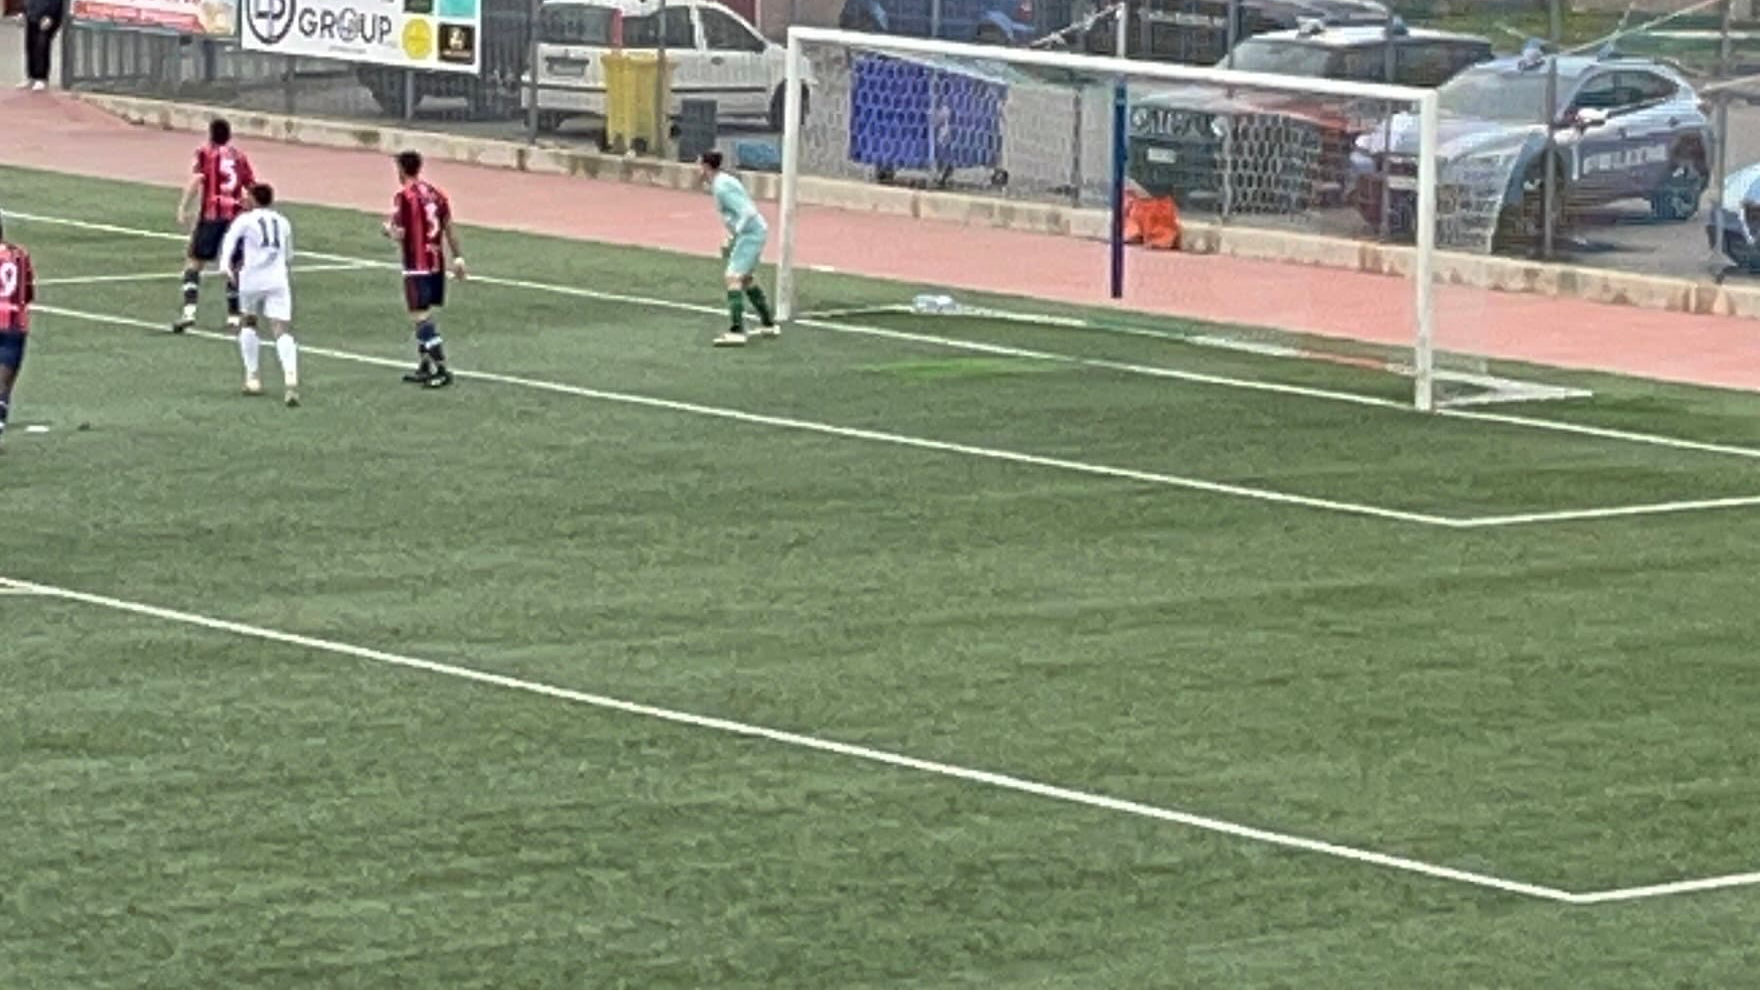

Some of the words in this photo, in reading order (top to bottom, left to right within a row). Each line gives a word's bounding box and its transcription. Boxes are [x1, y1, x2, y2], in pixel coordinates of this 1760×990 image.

[297, 7, 393, 44] GROUP
[219, 158, 238, 191] 5
[257, 216, 281, 250] 11
